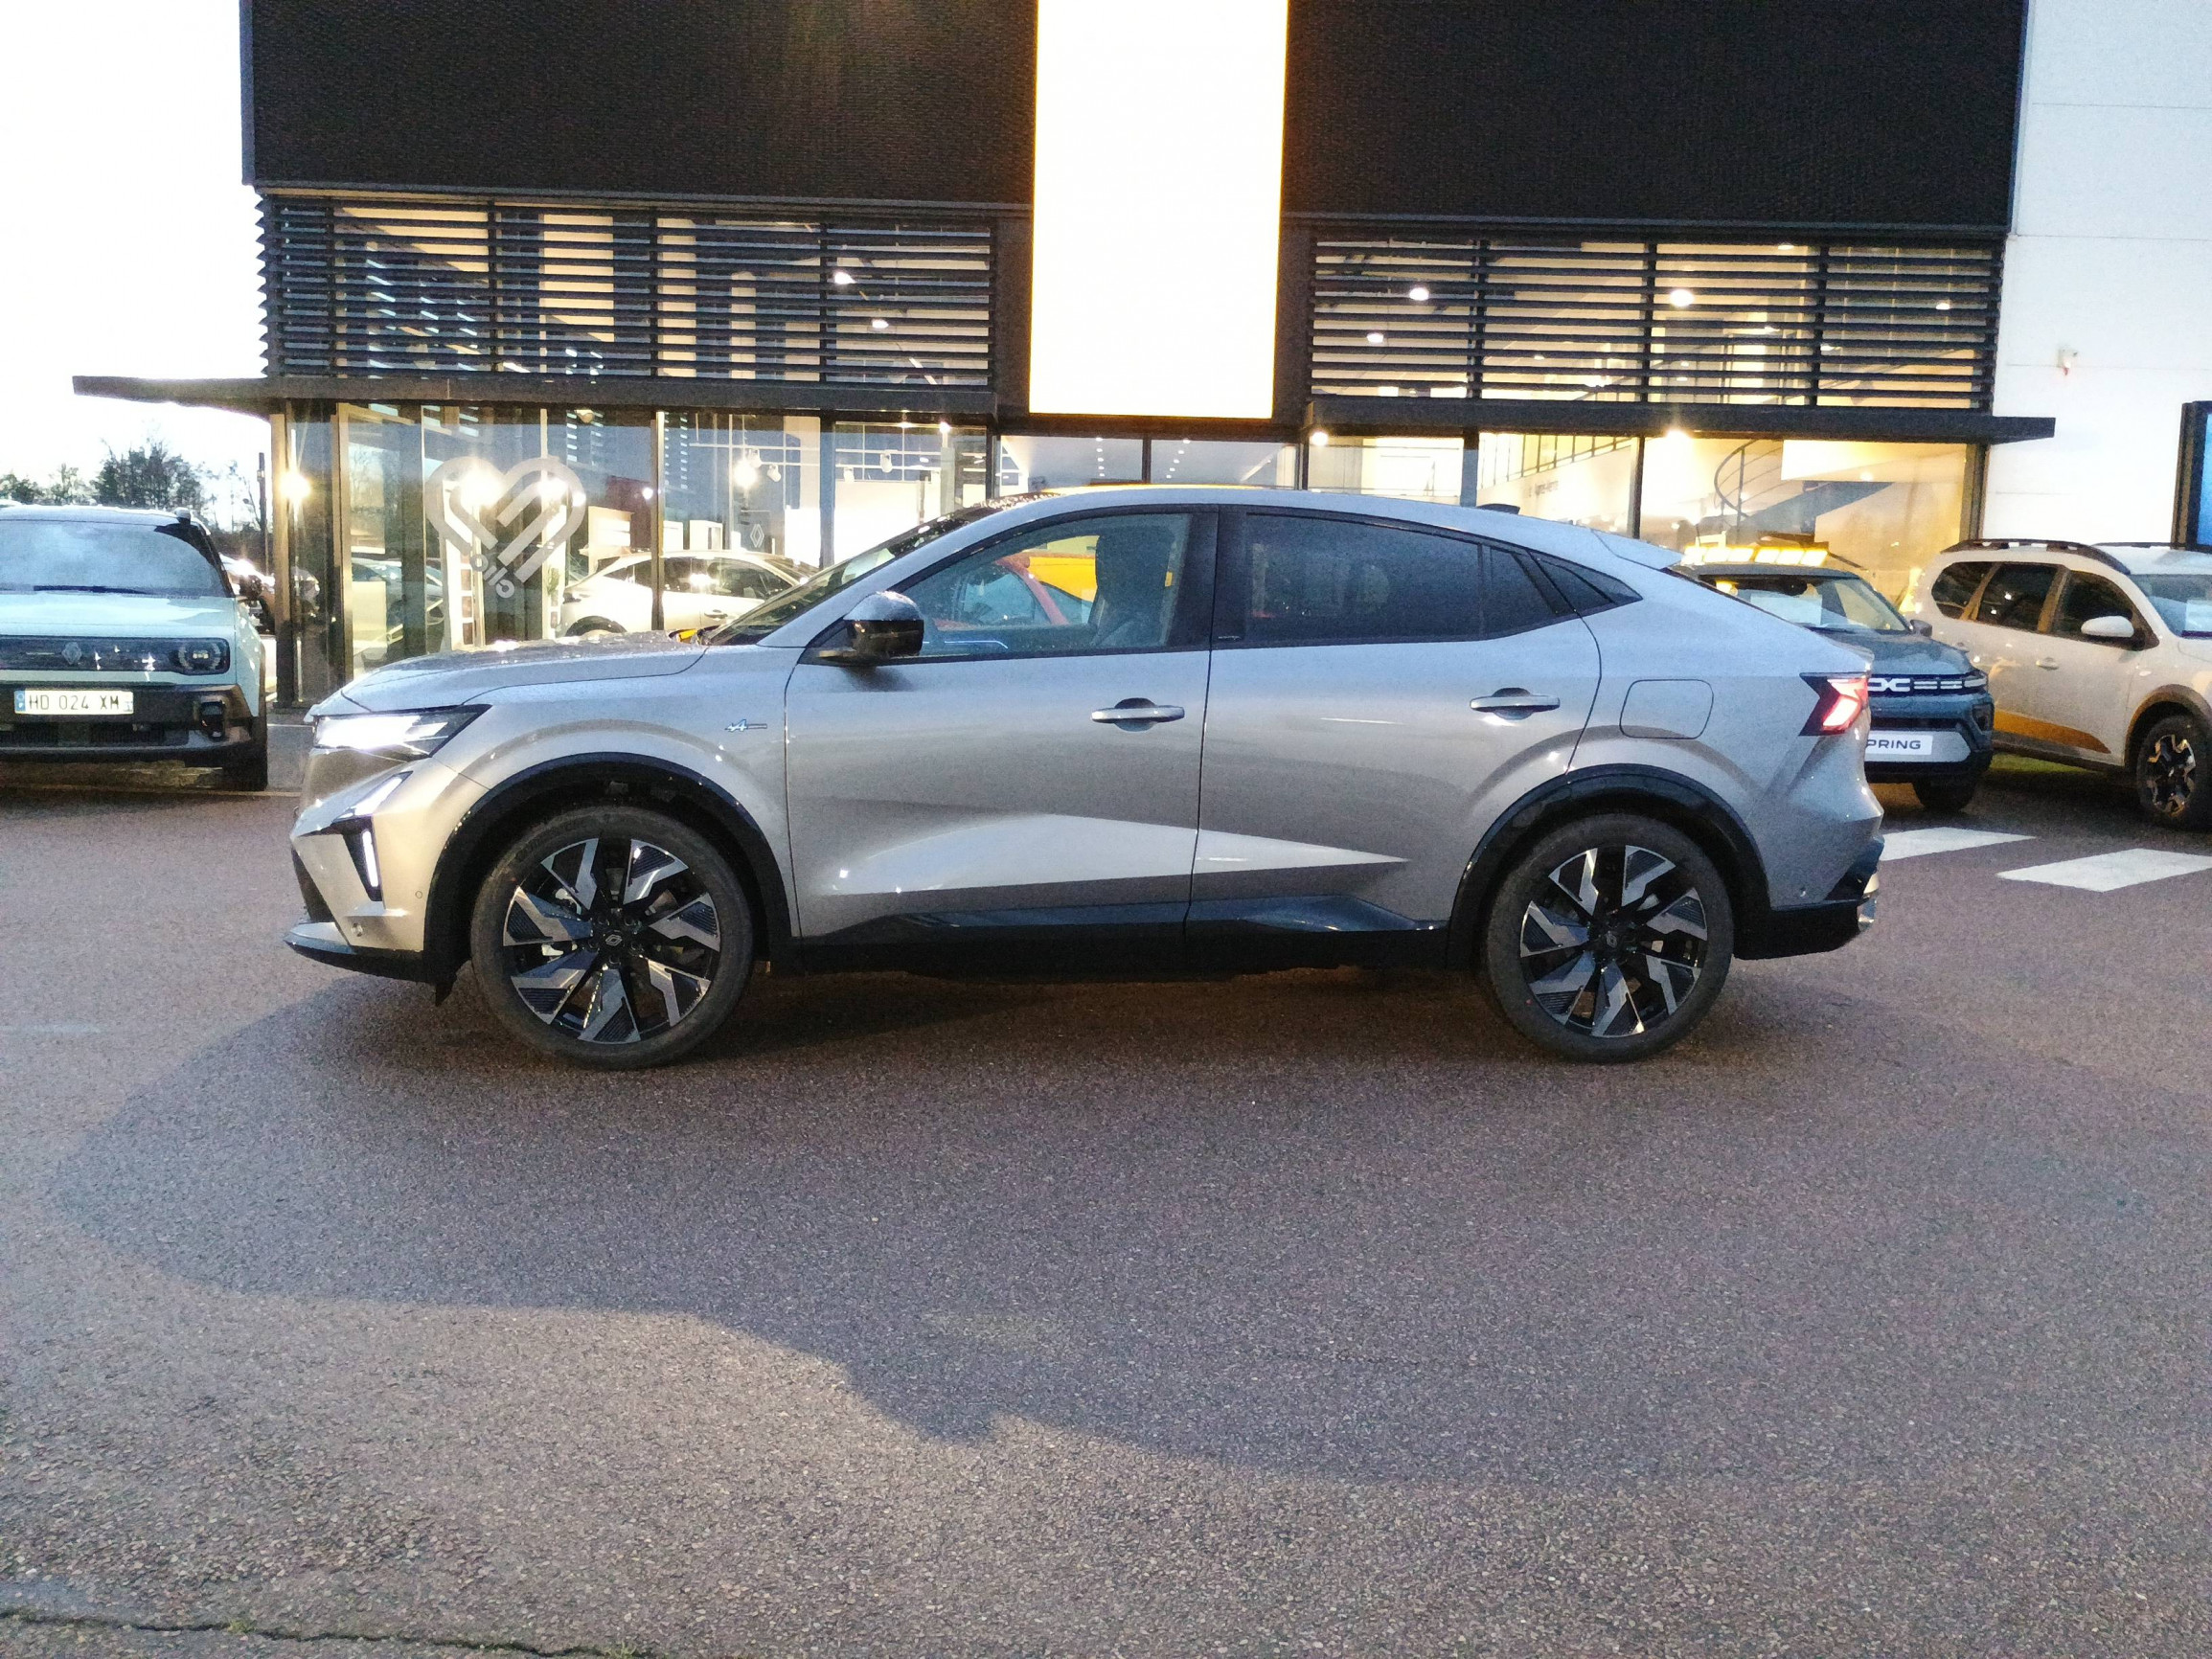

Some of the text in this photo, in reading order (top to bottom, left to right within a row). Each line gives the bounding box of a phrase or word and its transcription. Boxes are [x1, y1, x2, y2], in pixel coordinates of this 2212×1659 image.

[29, 694, 49, 710] HD
[58, 694, 89, 710] 024
[1866, 739, 1921, 749] PRING
